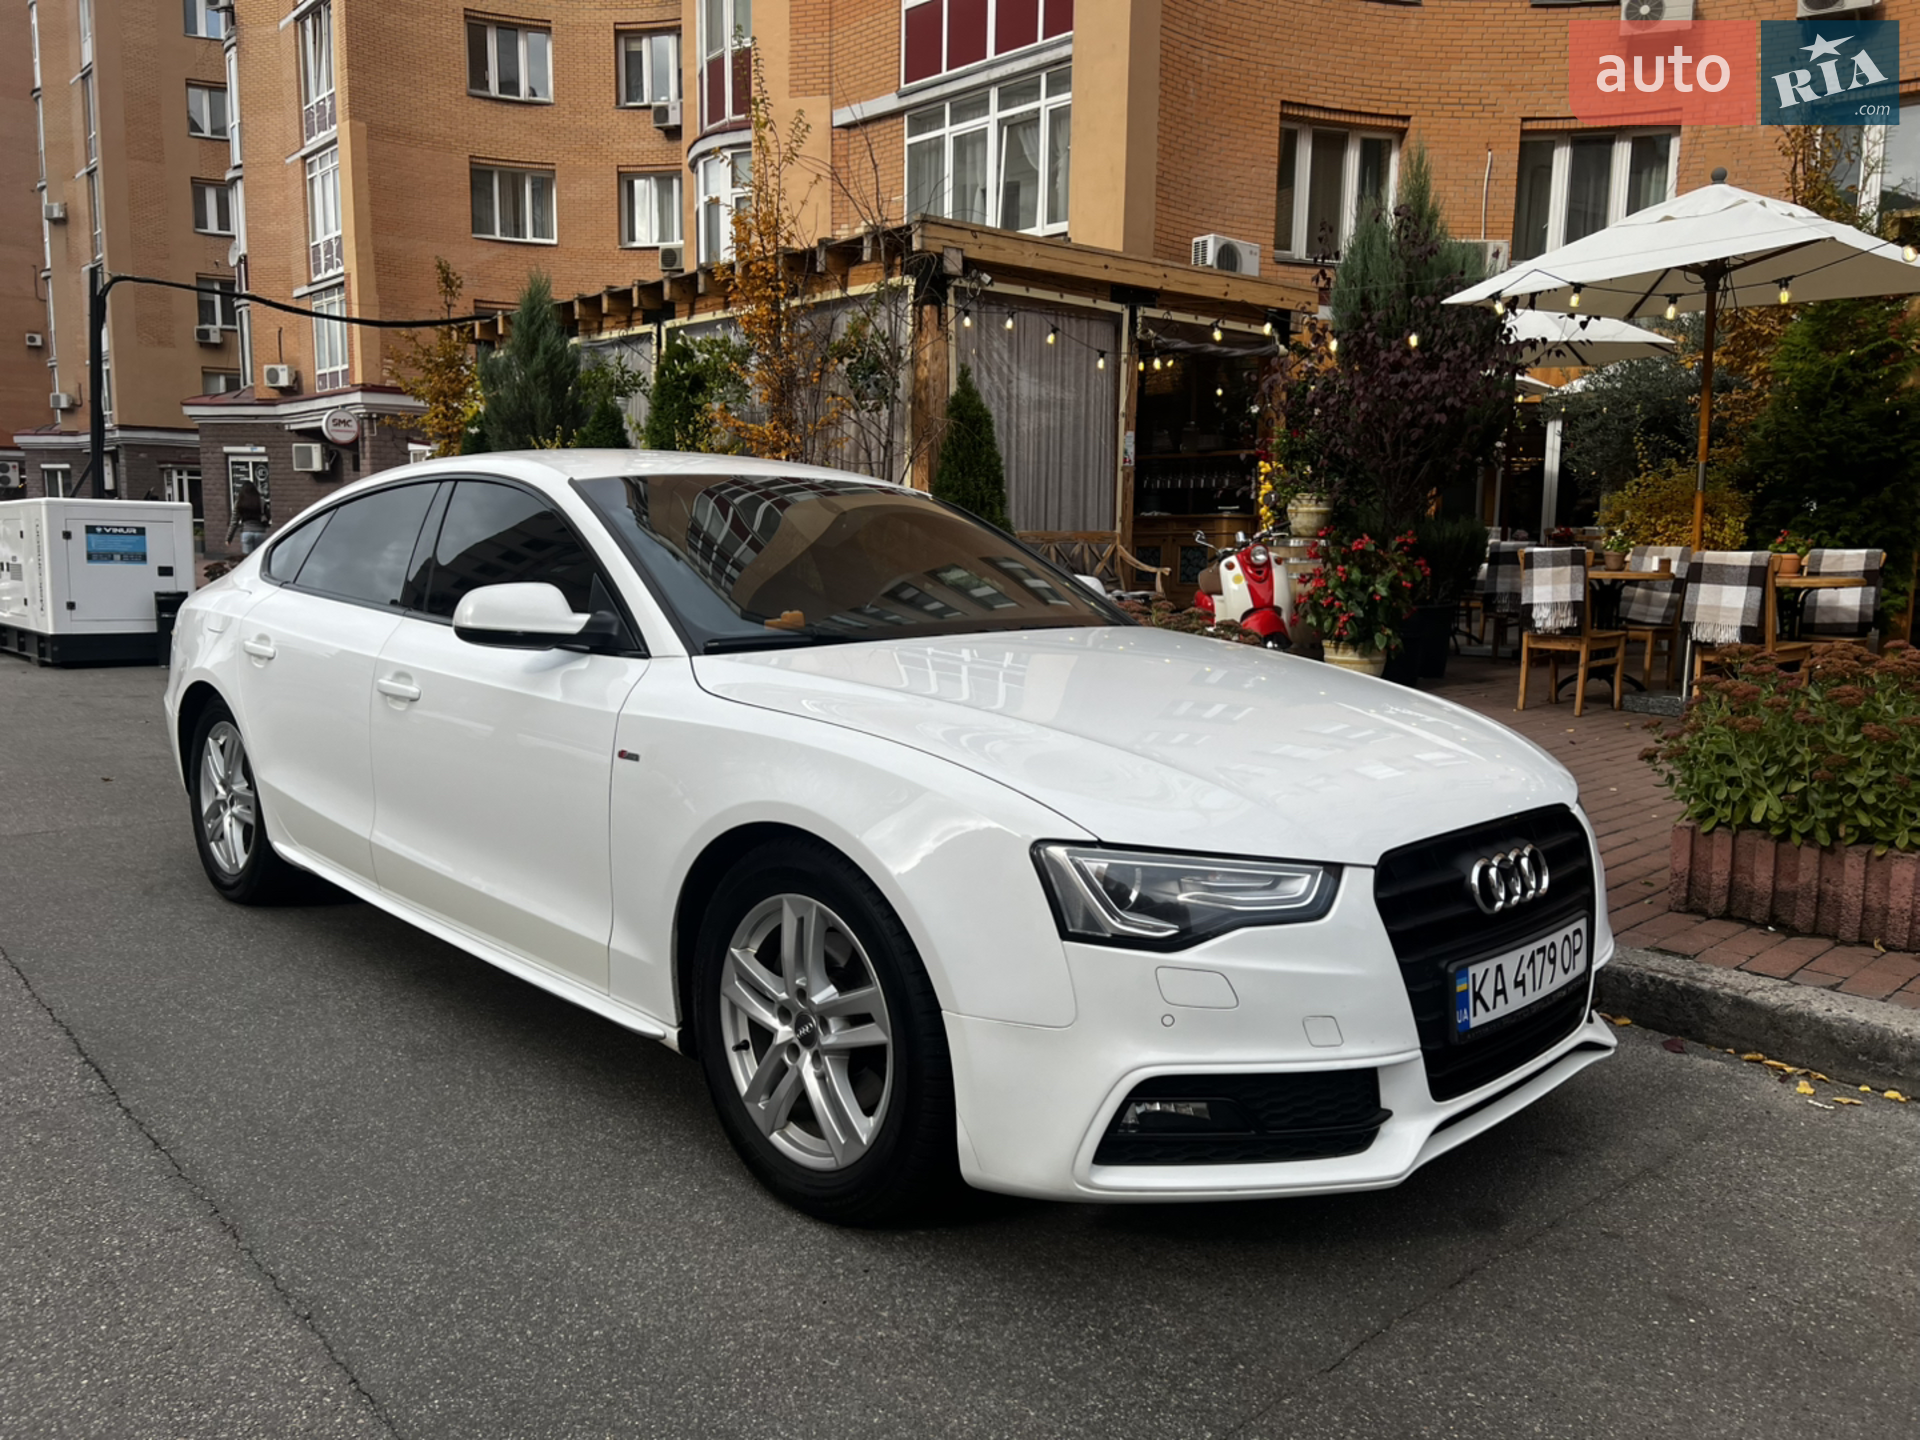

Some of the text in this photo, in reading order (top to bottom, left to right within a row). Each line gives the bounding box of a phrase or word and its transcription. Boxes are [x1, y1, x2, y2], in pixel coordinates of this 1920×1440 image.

[1471, 927, 1584, 1018] KA 4179 OP
[1456, 1008, 1469, 1024] UA
